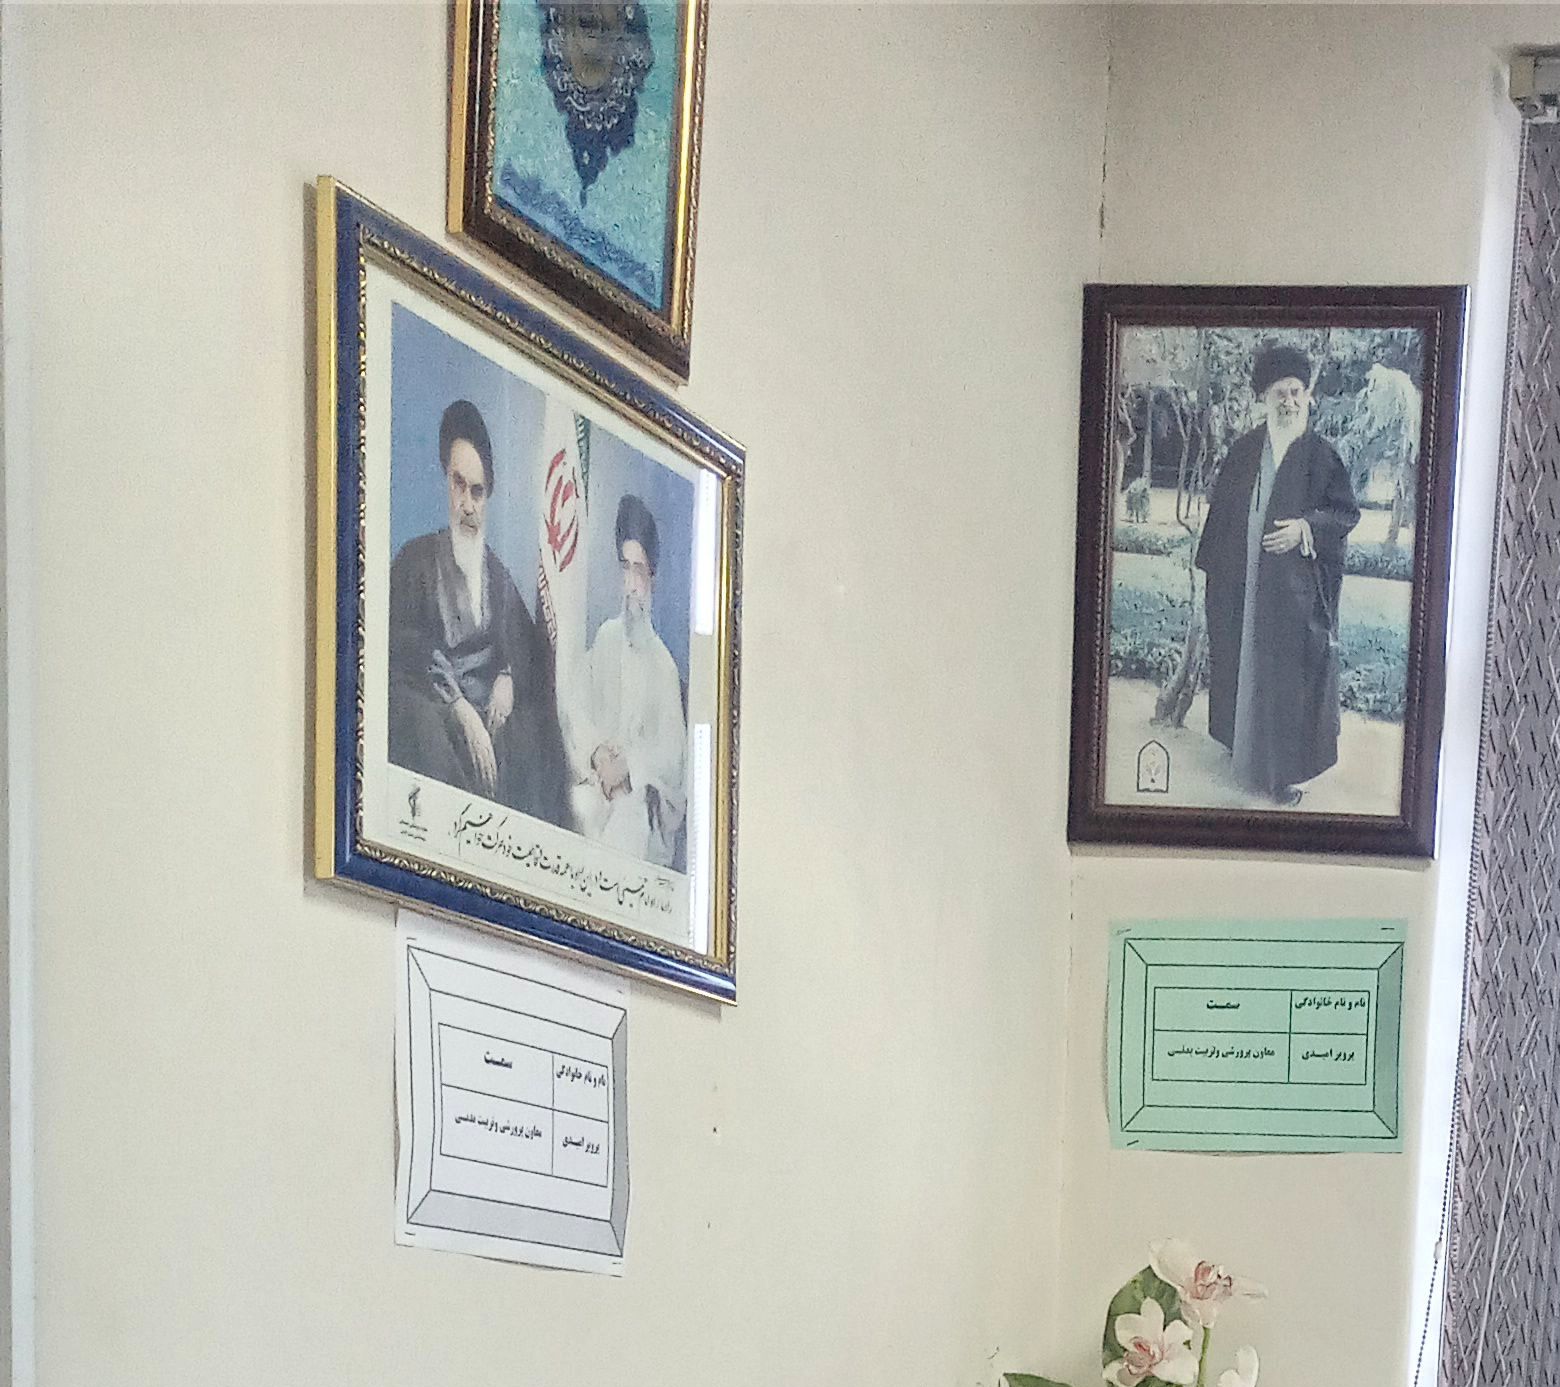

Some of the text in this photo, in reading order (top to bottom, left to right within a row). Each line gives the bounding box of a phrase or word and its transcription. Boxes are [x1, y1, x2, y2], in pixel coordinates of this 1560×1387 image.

[1295, 996, 1333, 1009] خانوادگی
[1334, 997, 1346, 1010] نام
[1354, 997, 1366, 1008] نام
[1221, 1046, 1251, 1059] پرورشی
[1252, 1046, 1275, 1059] معاون
